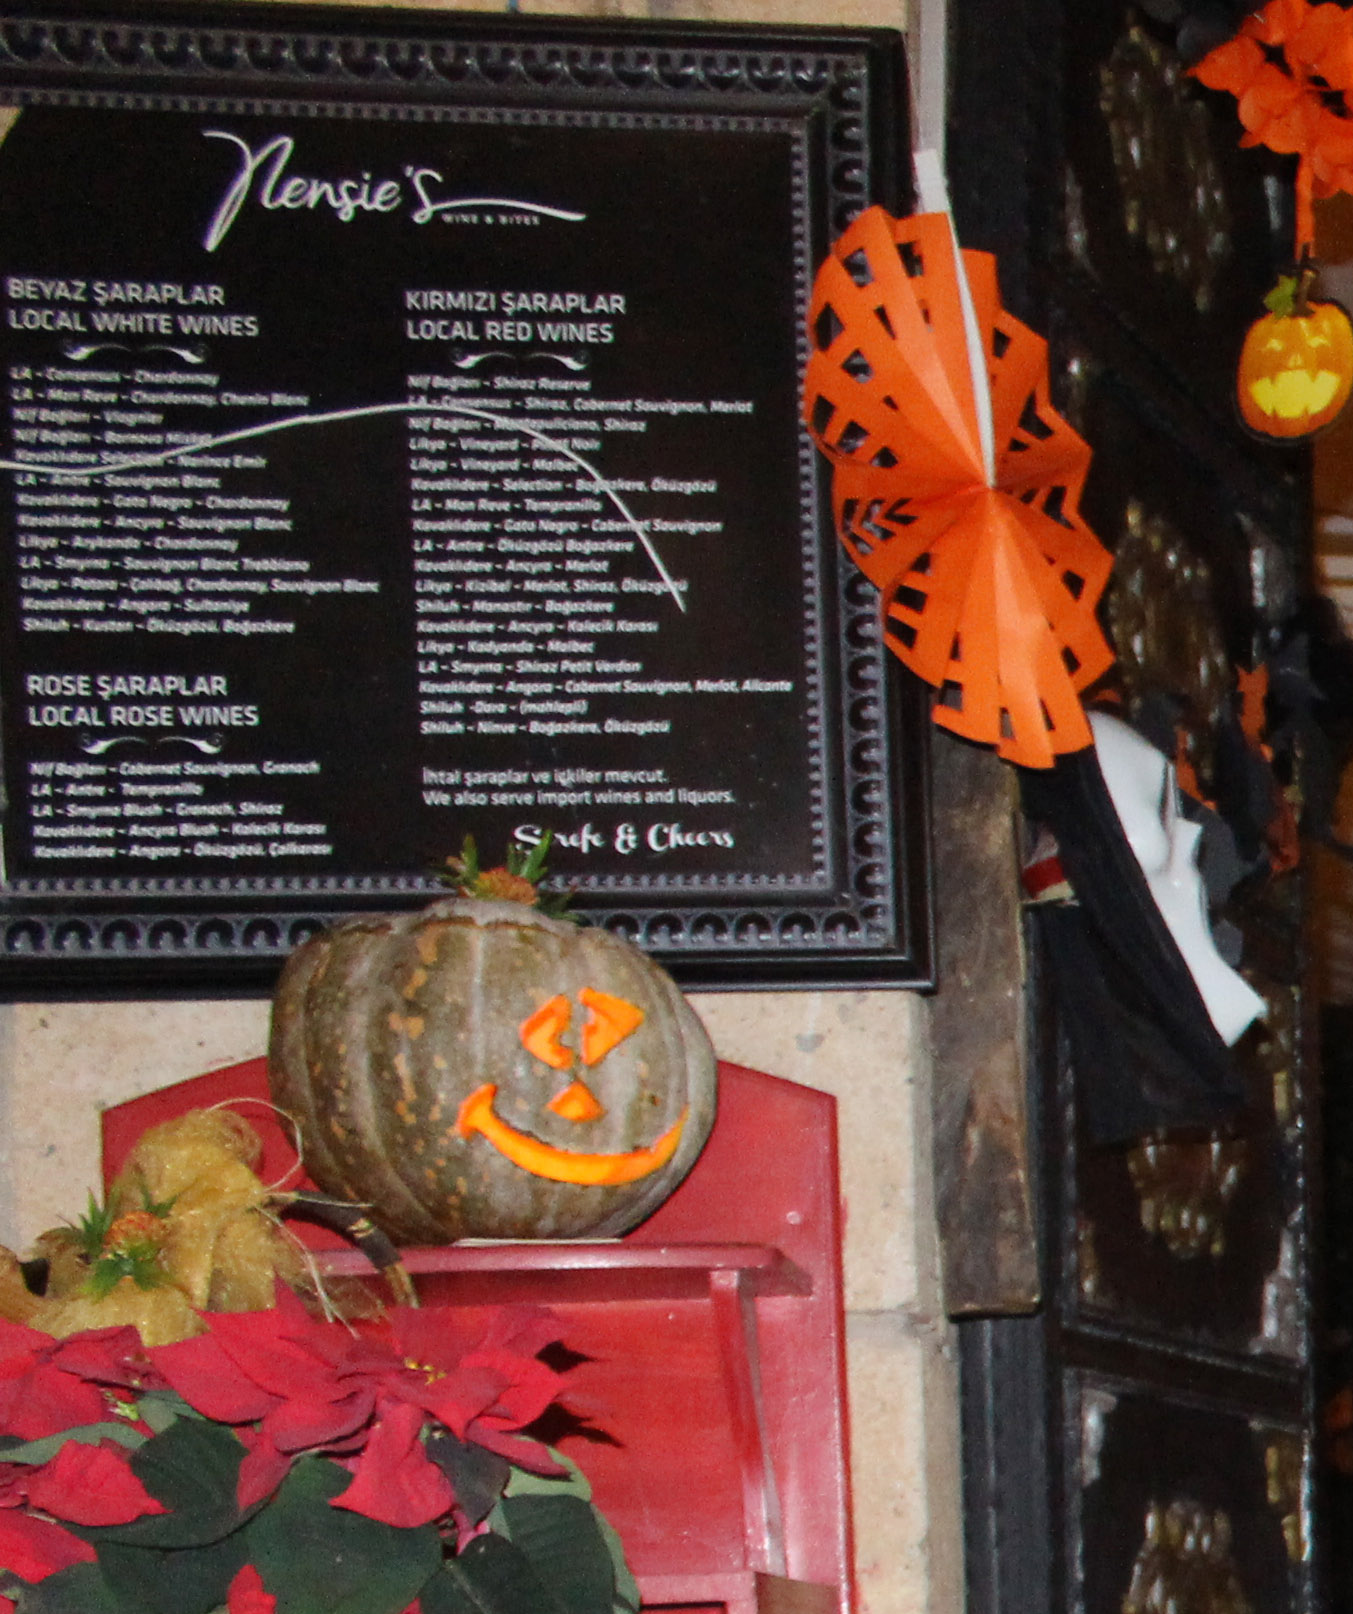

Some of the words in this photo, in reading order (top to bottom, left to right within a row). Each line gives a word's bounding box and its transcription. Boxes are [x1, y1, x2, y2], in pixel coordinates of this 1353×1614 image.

[6, 276, 86, 301] BEYAZ
[405, 290, 496, 310] KIRMIZI
[8, 307, 86, 331] LOCAL
[91, 310, 172, 334] WHITE
[176, 312, 258, 336] WINES
[406, 319, 479, 340] LOCAL
[484, 320, 532, 341] RED
[536, 322, 613, 342] WINES
[26, 674, 90, 695] ROSE
[28, 705, 104, 726] LOCAL
[109, 705, 173, 725] ROSE
[178, 705, 259, 725] WINES
[530, 771, 551, 783] ve
[422, 790, 451, 804] We
[453, 790, 488, 805] also
[490, 792, 534, 804] serve
[536, 790, 591, 805] import
[593, 790, 642, 803] wines
[644, 788, 675, 803] and
[615, 823, 638, 854] &
[647, 822, 735, 852] Cheers
